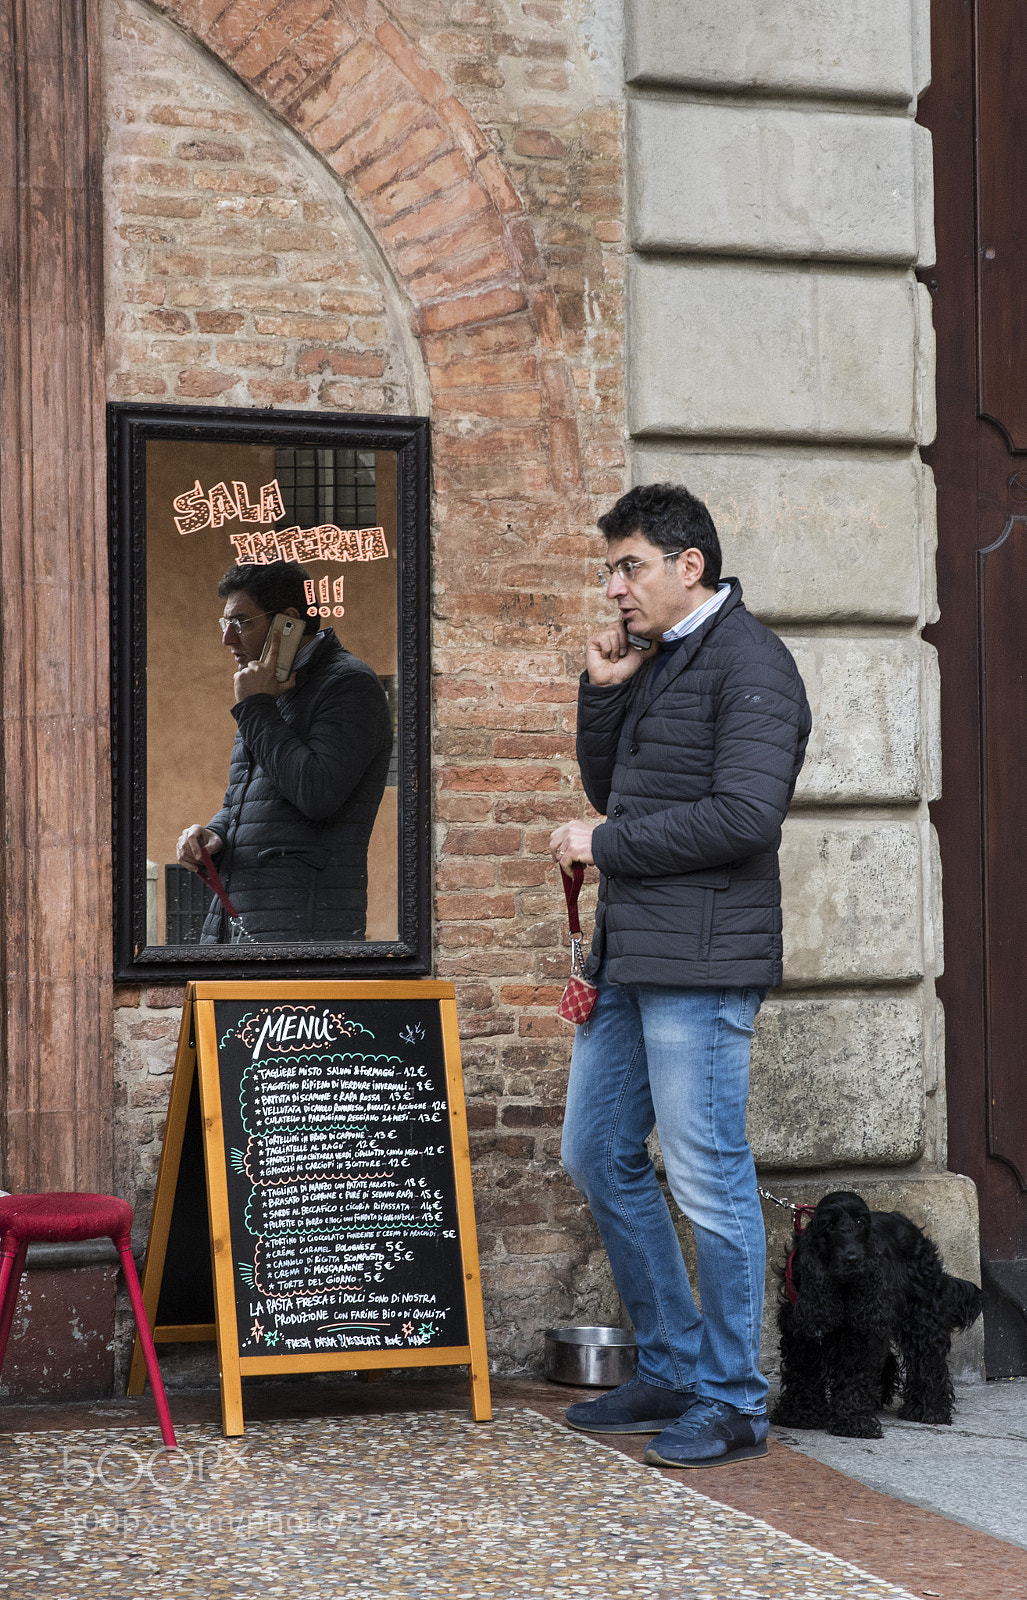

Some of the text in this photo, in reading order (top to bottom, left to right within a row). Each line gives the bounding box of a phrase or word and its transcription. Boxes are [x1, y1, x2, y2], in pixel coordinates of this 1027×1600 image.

[173, 479, 286, 535] SALA
[229, 524, 389, 566] INTERNA
[262, 1105, 302, 1116] VELLUTATA
[344, 1160, 352, 1170] 3
[277, 1280, 305, 1291] TORTE
[307, 1278, 324, 1287] DEL
[249, 1300, 265, 1317] LA
[265, 1297, 294, 1315] PASTA
[295, 1294, 329, 1310] FRESCA
[367, 1292, 389, 1303] SONO
[401, 1292, 437, 1304] NOSTRA
[274, 1308, 330, 1329] PRODUZIONE
[333, 1311, 349, 1320] CON
[350, 1308, 380, 1320] FARINE
